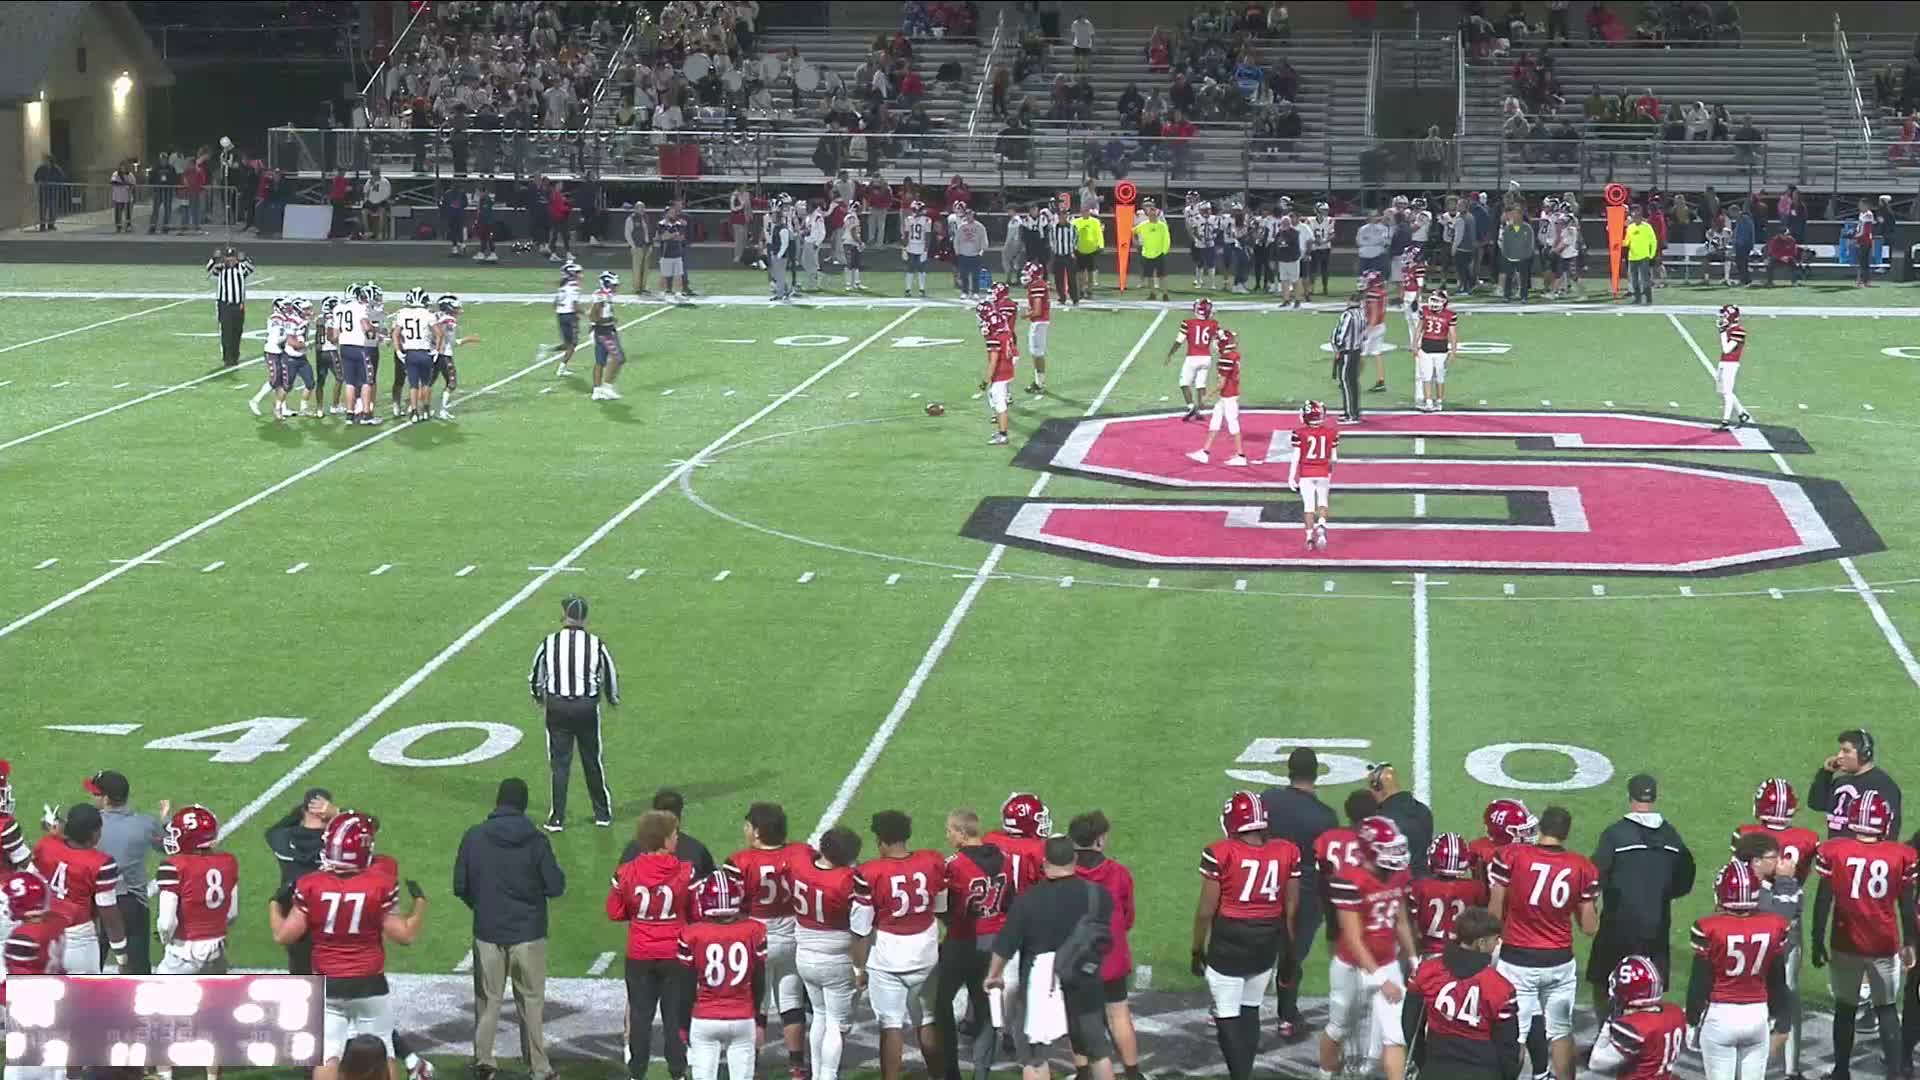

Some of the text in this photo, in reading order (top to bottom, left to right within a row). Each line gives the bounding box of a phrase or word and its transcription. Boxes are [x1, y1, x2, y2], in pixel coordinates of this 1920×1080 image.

[910, 223, 923, 240] 19
[336, 309, 354, 333] 79
[404, 317, 423, 340] 51
[1195, 325, 1211, 345] 16
[1426, 320, 1442, 334] 33
[1305, 435, 1326, 459] 21
[182, 811, 199, 831] S
[49, 860, 70, 900] 4
[205, 867, 226, 910] 8
[890, 871, 930, 918] 53
[1239, 858, 1281, 902] 74
[1528, 862, 1573, 909] 76
[1846, 857, 1890, 900] 78
[320, 891, 367, 935] 77
[634, 884, 677, 920] 22
[792, 879, 825, 924] 51
[704, 941, 749, 987] 89
[1619, 964, 1633, 985] S
[1724, 932, 1771, 978] 57
[1434, 980, 1481, 1028] 64
